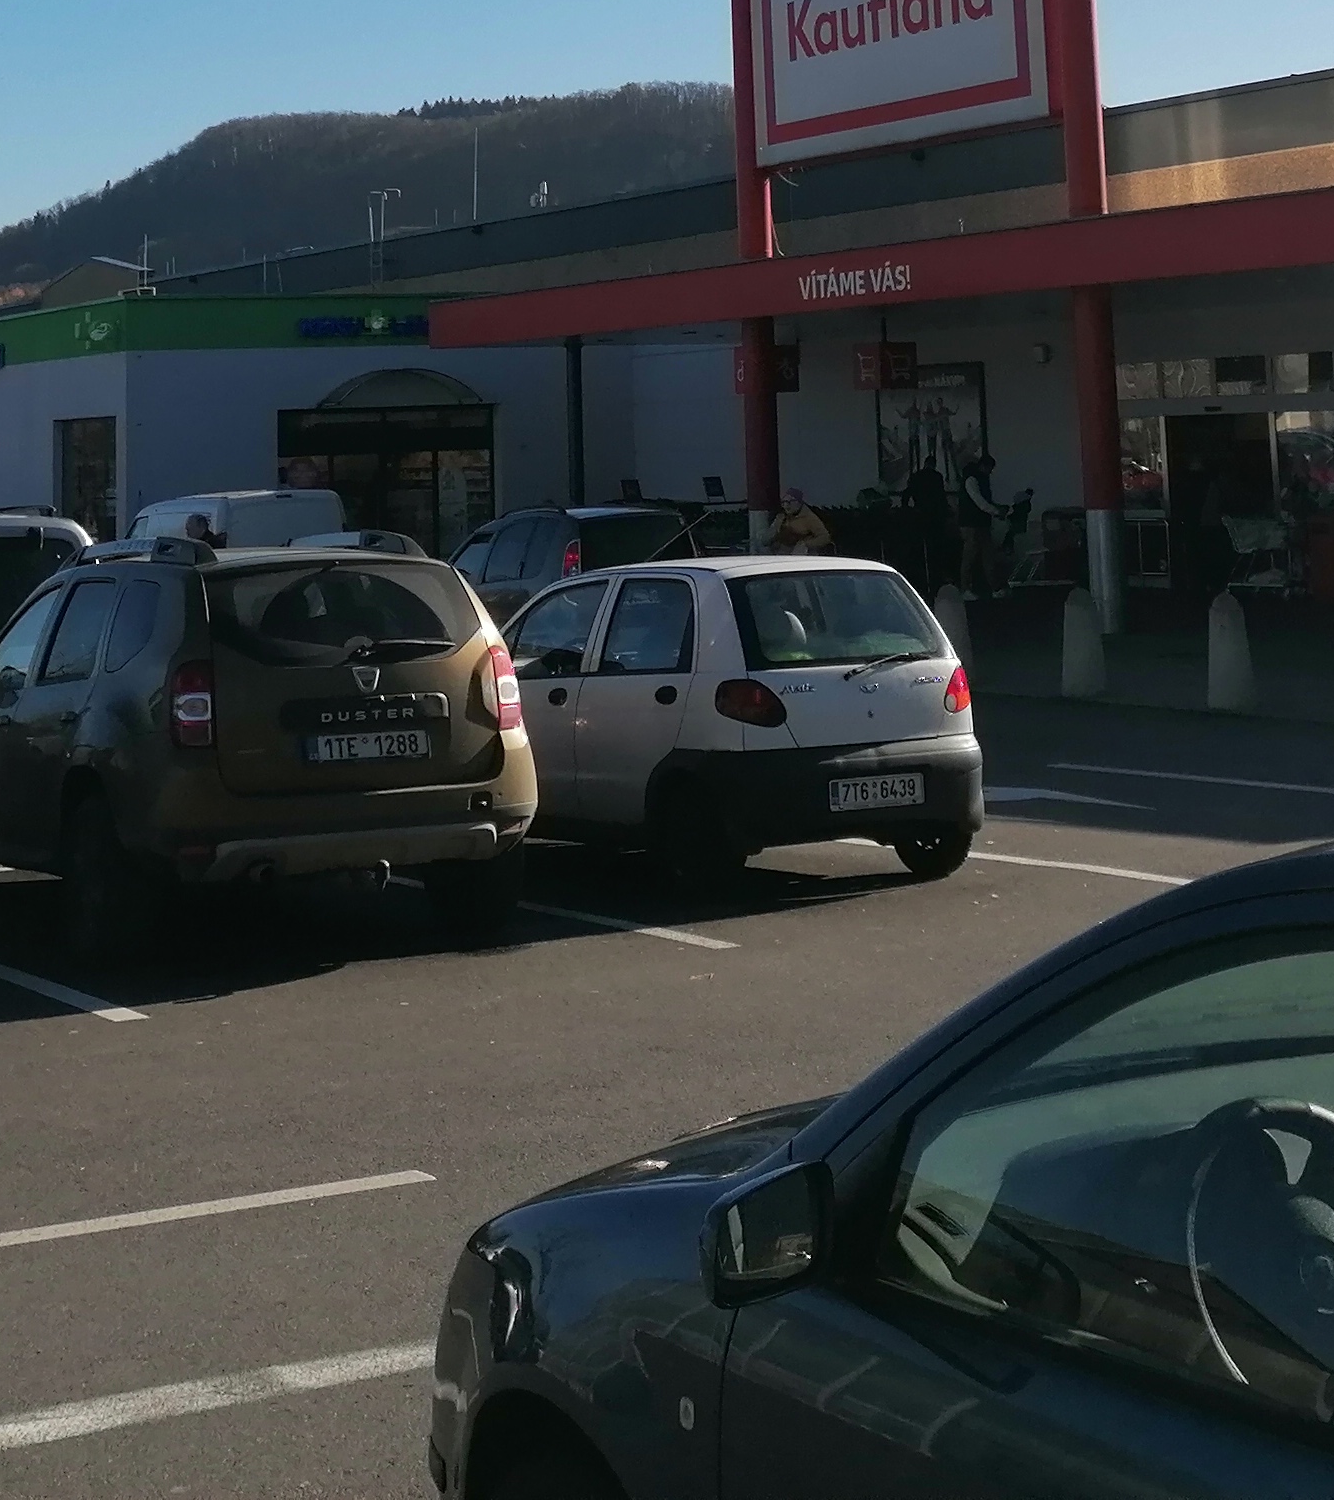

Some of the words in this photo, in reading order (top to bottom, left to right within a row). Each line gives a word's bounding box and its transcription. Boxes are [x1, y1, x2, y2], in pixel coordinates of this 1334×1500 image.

[798, 268, 867, 301] VÍTÁME
[869, 260, 912, 294] VÁS!
[320, 707, 416, 723] DUSTER
[324, 736, 360, 759] 1TE
[374, 733, 419, 756] 1288
[842, 781, 870, 802] 7T6
[880, 778, 917, 799] 6439
